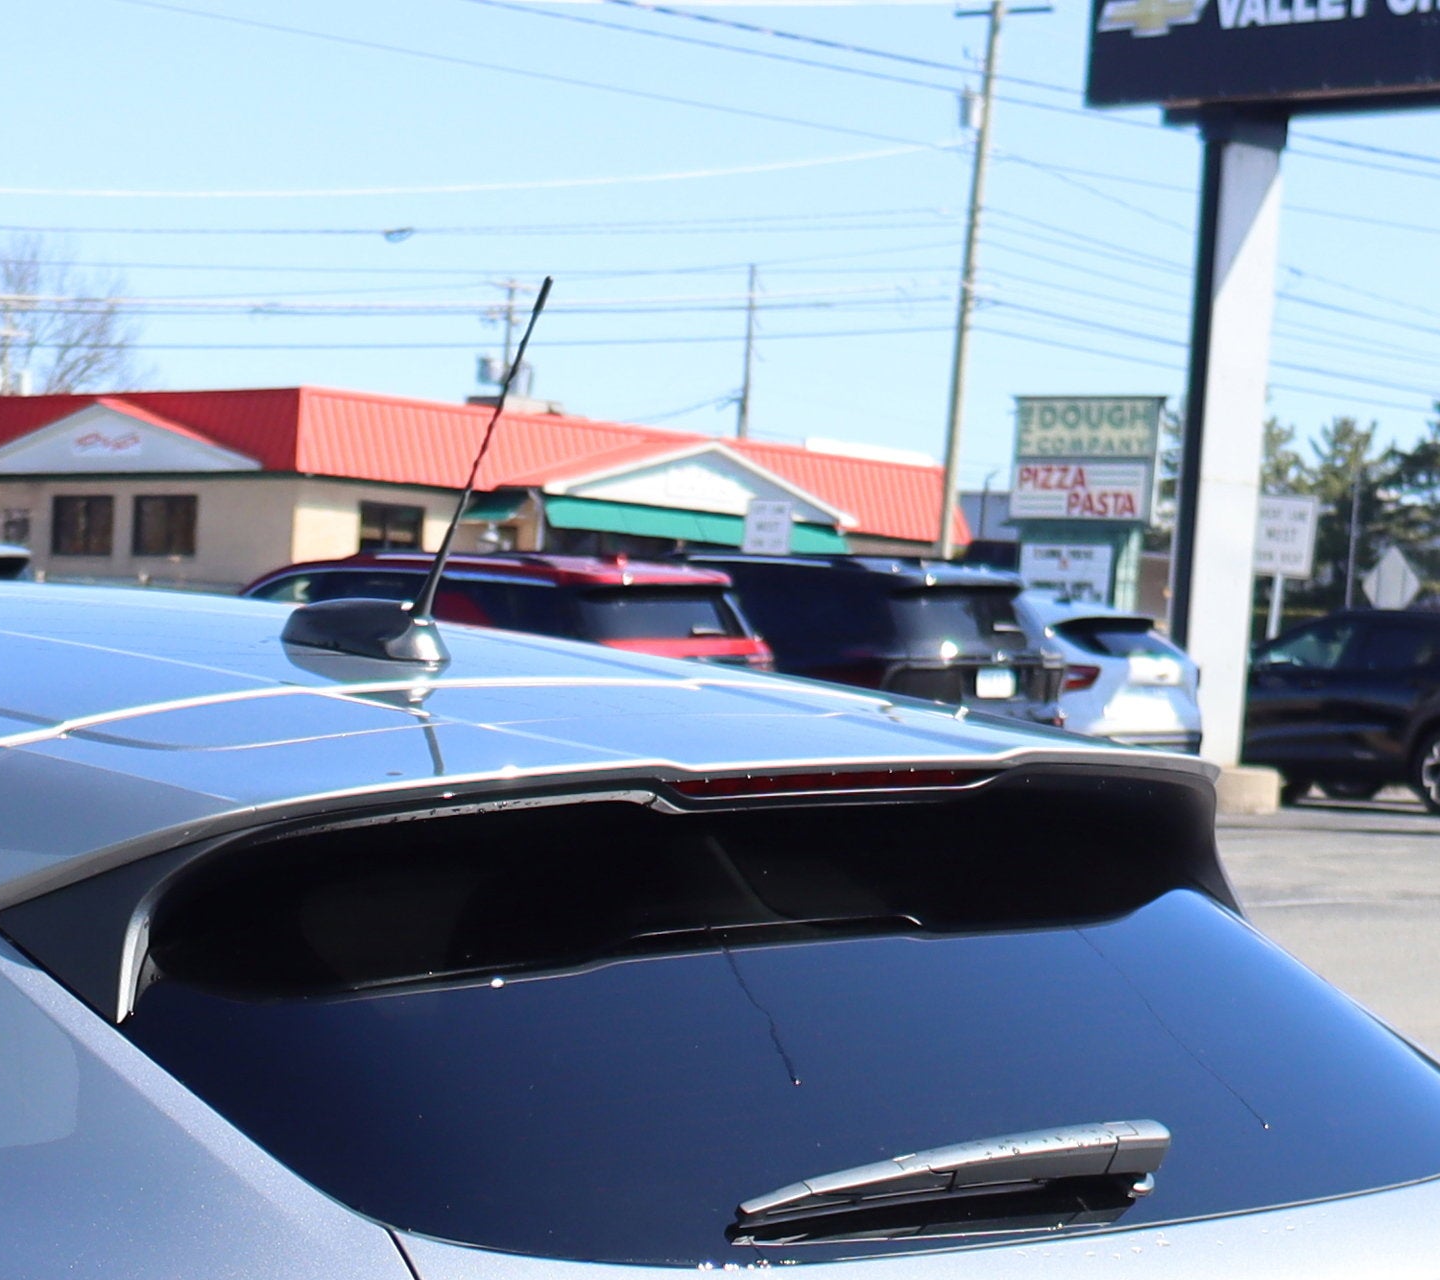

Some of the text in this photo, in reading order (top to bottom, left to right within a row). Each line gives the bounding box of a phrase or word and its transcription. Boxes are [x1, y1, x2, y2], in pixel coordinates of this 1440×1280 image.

[1039, 404, 1153, 429] DOUGH
[1038, 437, 1148, 453] COMPANY
[1019, 466, 1086, 491] PIZZA
[1067, 492, 1136, 516] PASTA
